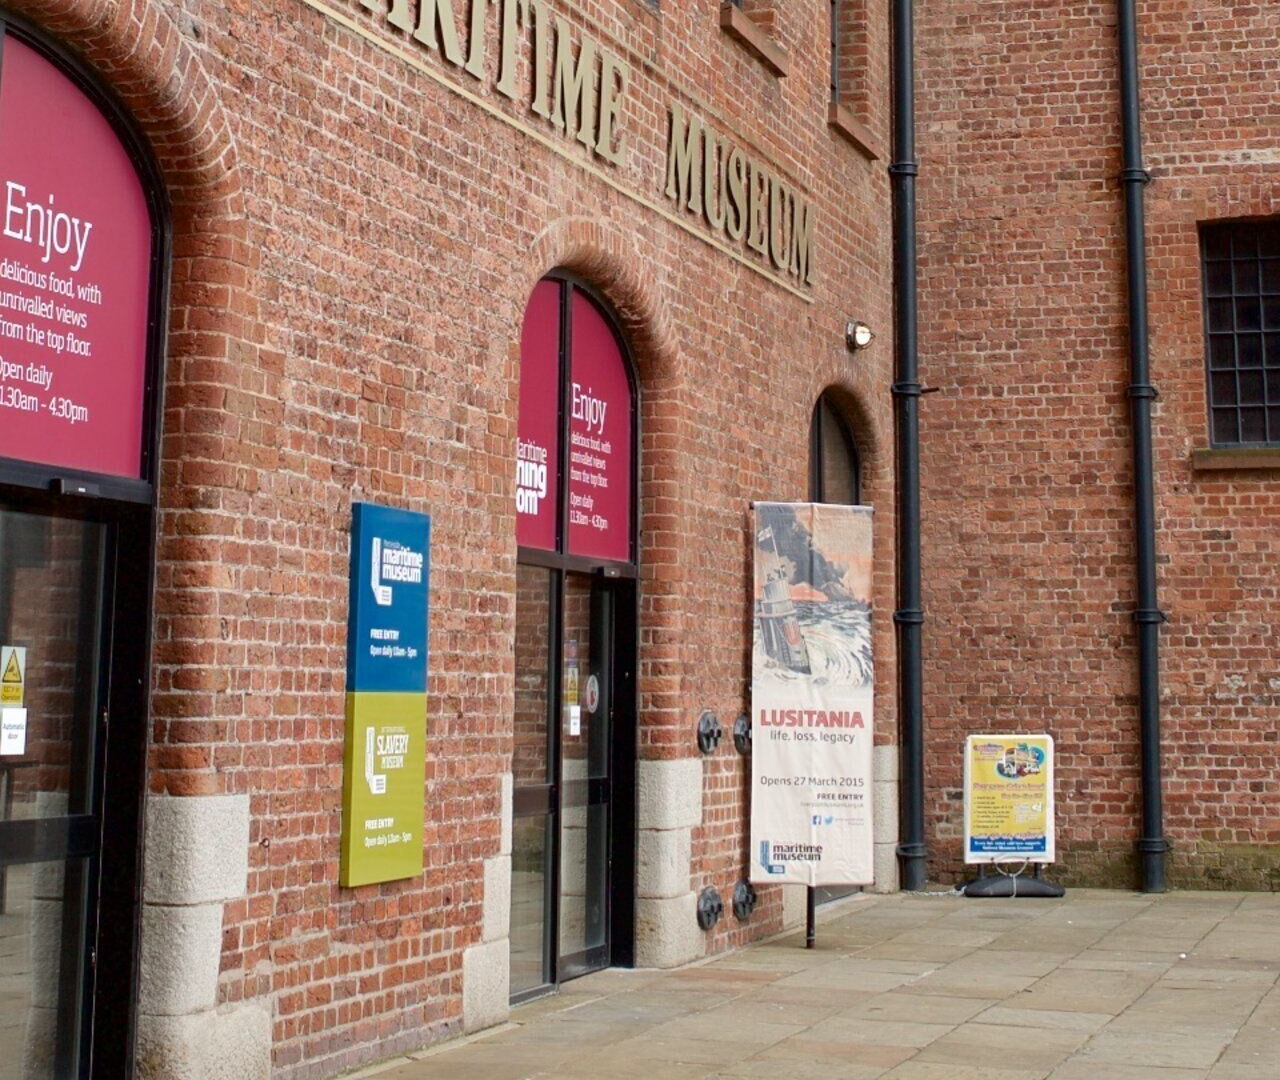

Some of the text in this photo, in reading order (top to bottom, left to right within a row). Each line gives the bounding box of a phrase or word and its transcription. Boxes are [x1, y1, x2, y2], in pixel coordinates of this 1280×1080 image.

[664, 101, 815, 286] MUSEUM
[3, 180, 93, 272] Enjoy
[0, 258, 102, 304] delicious food, with
[56, 303, 88, 328] views
[26, 322, 45, 345] the
[47, 329, 65, 354] top
[66, 332, 92, 357] floor.
[26, 362, 53, 391] daily
[48, 396, 89, 424] 4.30pm
[571, 382, 607, 434] Enjoy
[516, 436, 547, 464] aritime
[383, 546, 423, 569] maritime
[382, 564, 421, 584] museum
[760, 709, 865, 729] LUSITANIA
[377, 734, 409, 756] SLAVERY
[820, 731, 856, 745] legacy
[760, 775, 865, 787] Opens 27 March 2015
[773, 843, 823, 853] maritime
[773, 852, 821, 861] museum
